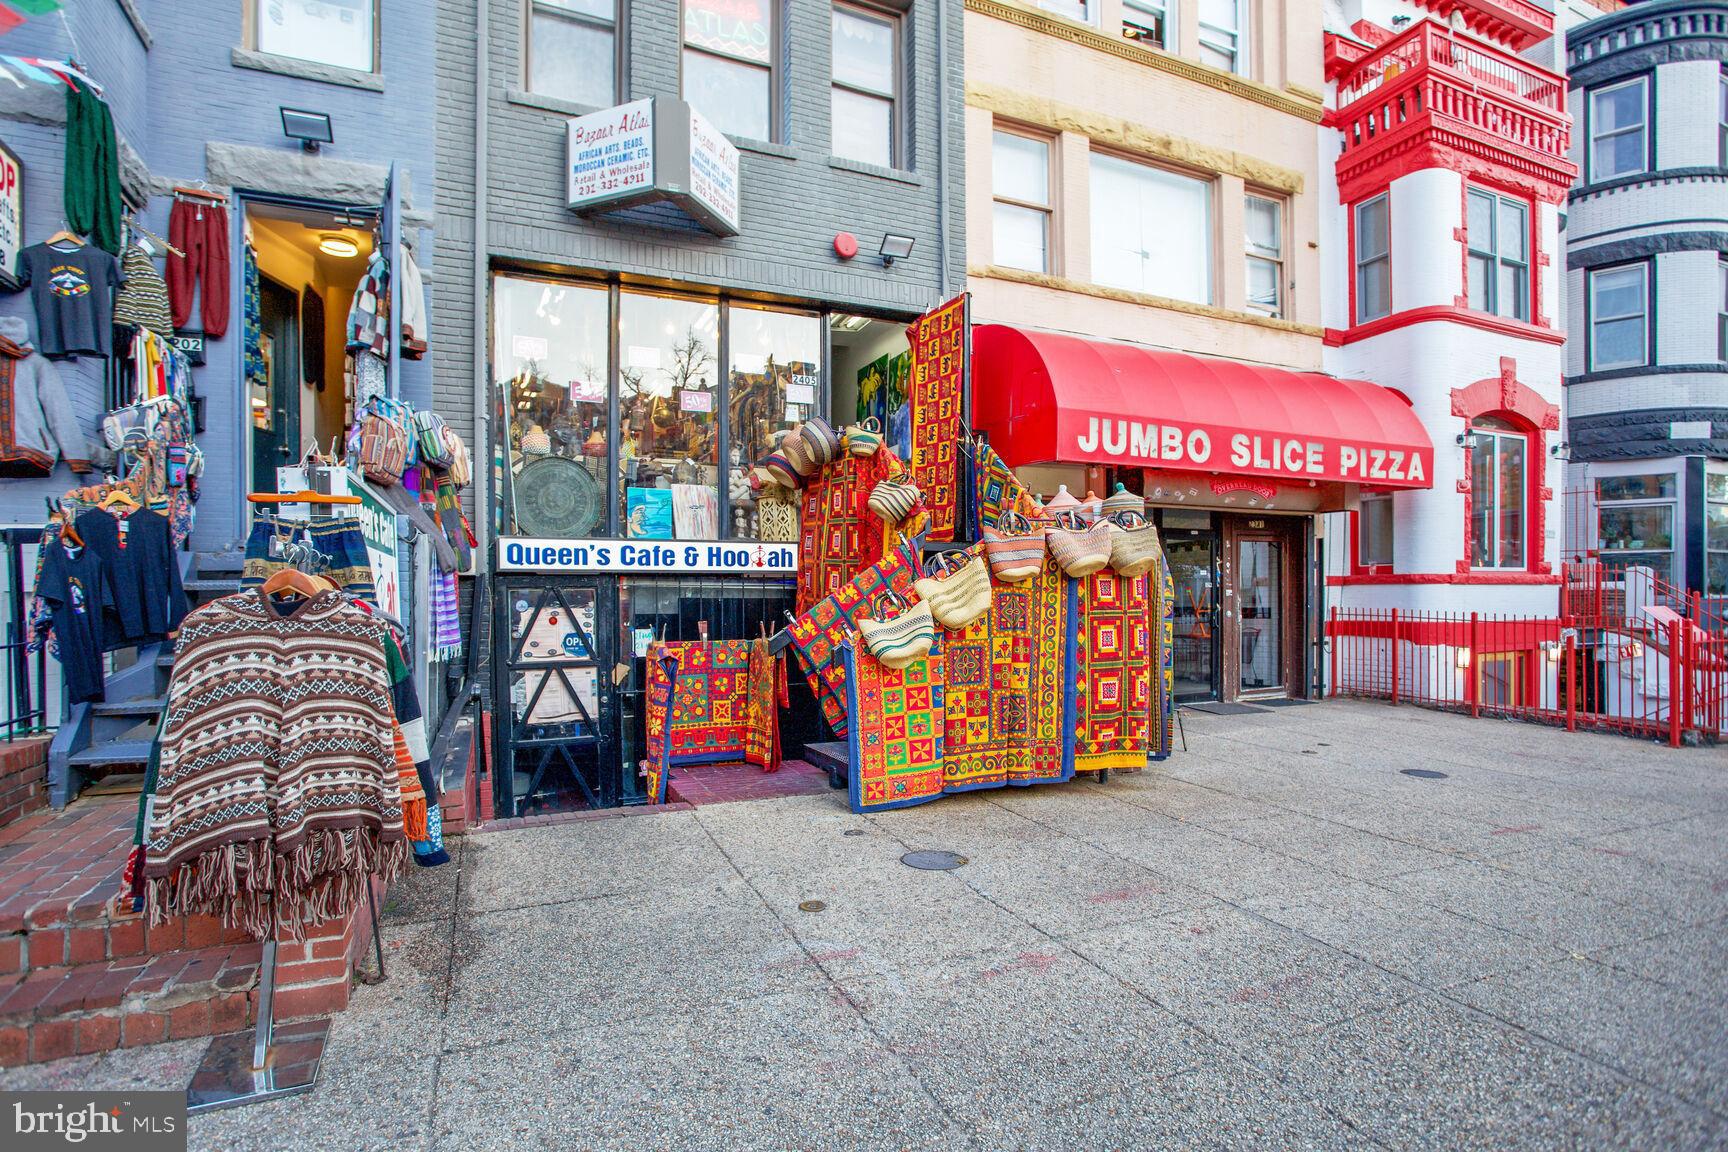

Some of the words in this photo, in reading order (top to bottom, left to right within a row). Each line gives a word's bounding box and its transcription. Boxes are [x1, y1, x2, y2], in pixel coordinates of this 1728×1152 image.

[684, 8, 767, 46] ATLAS
[576, 124, 614, 147] Bazaar
[578, 147, 602, 161] AFRICAN
[574, 159, 605, 173] MOROCCAN
[575, 172, 596, 185] Retail
[600, 170, 606, 180] &
[609, 160, 650, 177] Wholesale
[793, 375, 816, 385] 2405
[1078, 416, 1212, 464] JUMBO
[1230, 433, 1325, 475] SLICE
[1340, 445, 1426, 481] PIZZA
[506, 543, 611, 566] Queen's
[620, 545, 675, 567] Cafe
[684, 546, 699, 567] &
[1620, 643, 1639, 659] EXT
